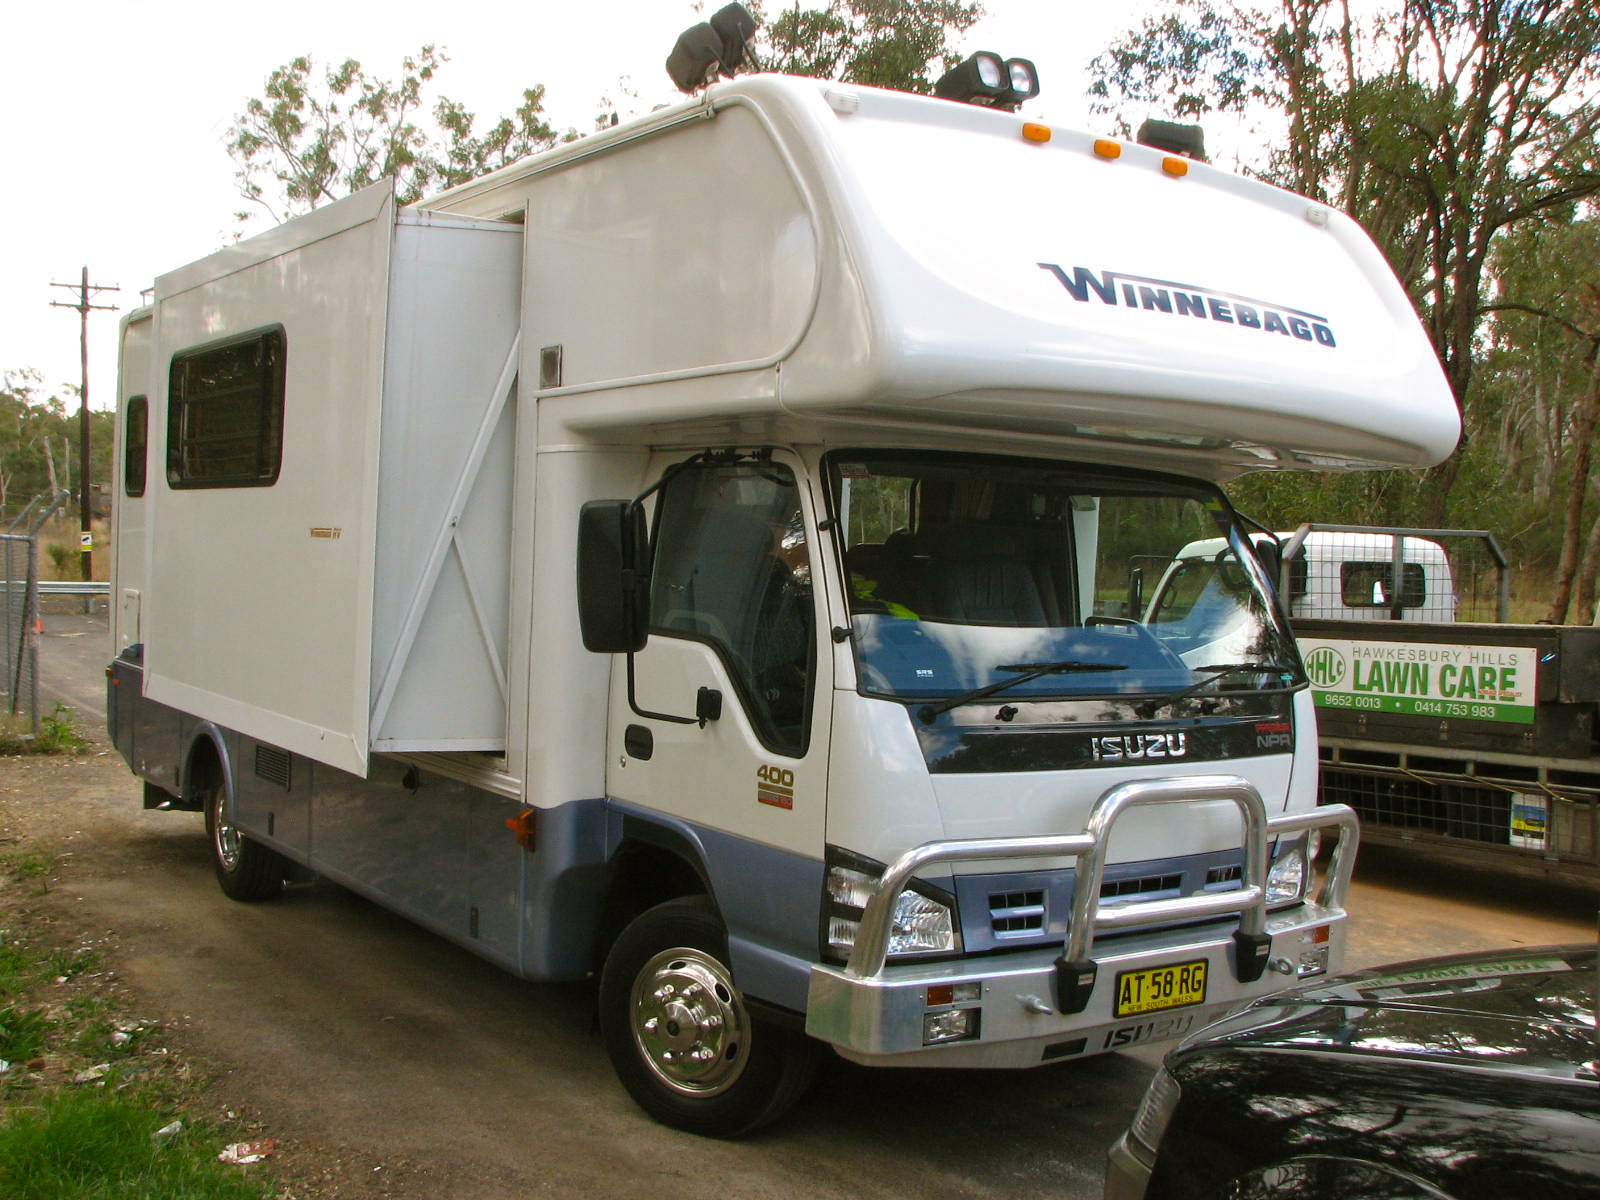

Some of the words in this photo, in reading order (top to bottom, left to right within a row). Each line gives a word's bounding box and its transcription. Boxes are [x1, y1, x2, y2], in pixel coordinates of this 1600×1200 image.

[1036, 262, 1337, 348] WINNEBAGO
[1352, 646, 1462, 664] HAWKESBURY
[1470, 651, 1519, 667] HILLS
[1352, 659, 1430, 696] LAWN
[1439, 664, 1517, 702] CARE
[1325, 694, 1351, 706] 9652
[1355, 697, 1381, 710] 0013
[1414, 701, 1442, 714] 0414
[1446, 704, 1468, 717] 753
[1471, 705, 1496, 718] 983
[1091, 732, 1186, 761] ISUZU
[1255, 733, 1291, 748] NPR
[757, 764, 794, 787] 400
[1127, 1003, 1142, 1012] NEW
[1145, 999, 1169, 1010] SOUTH
[1172, 994, 1193, 1004] WALES
